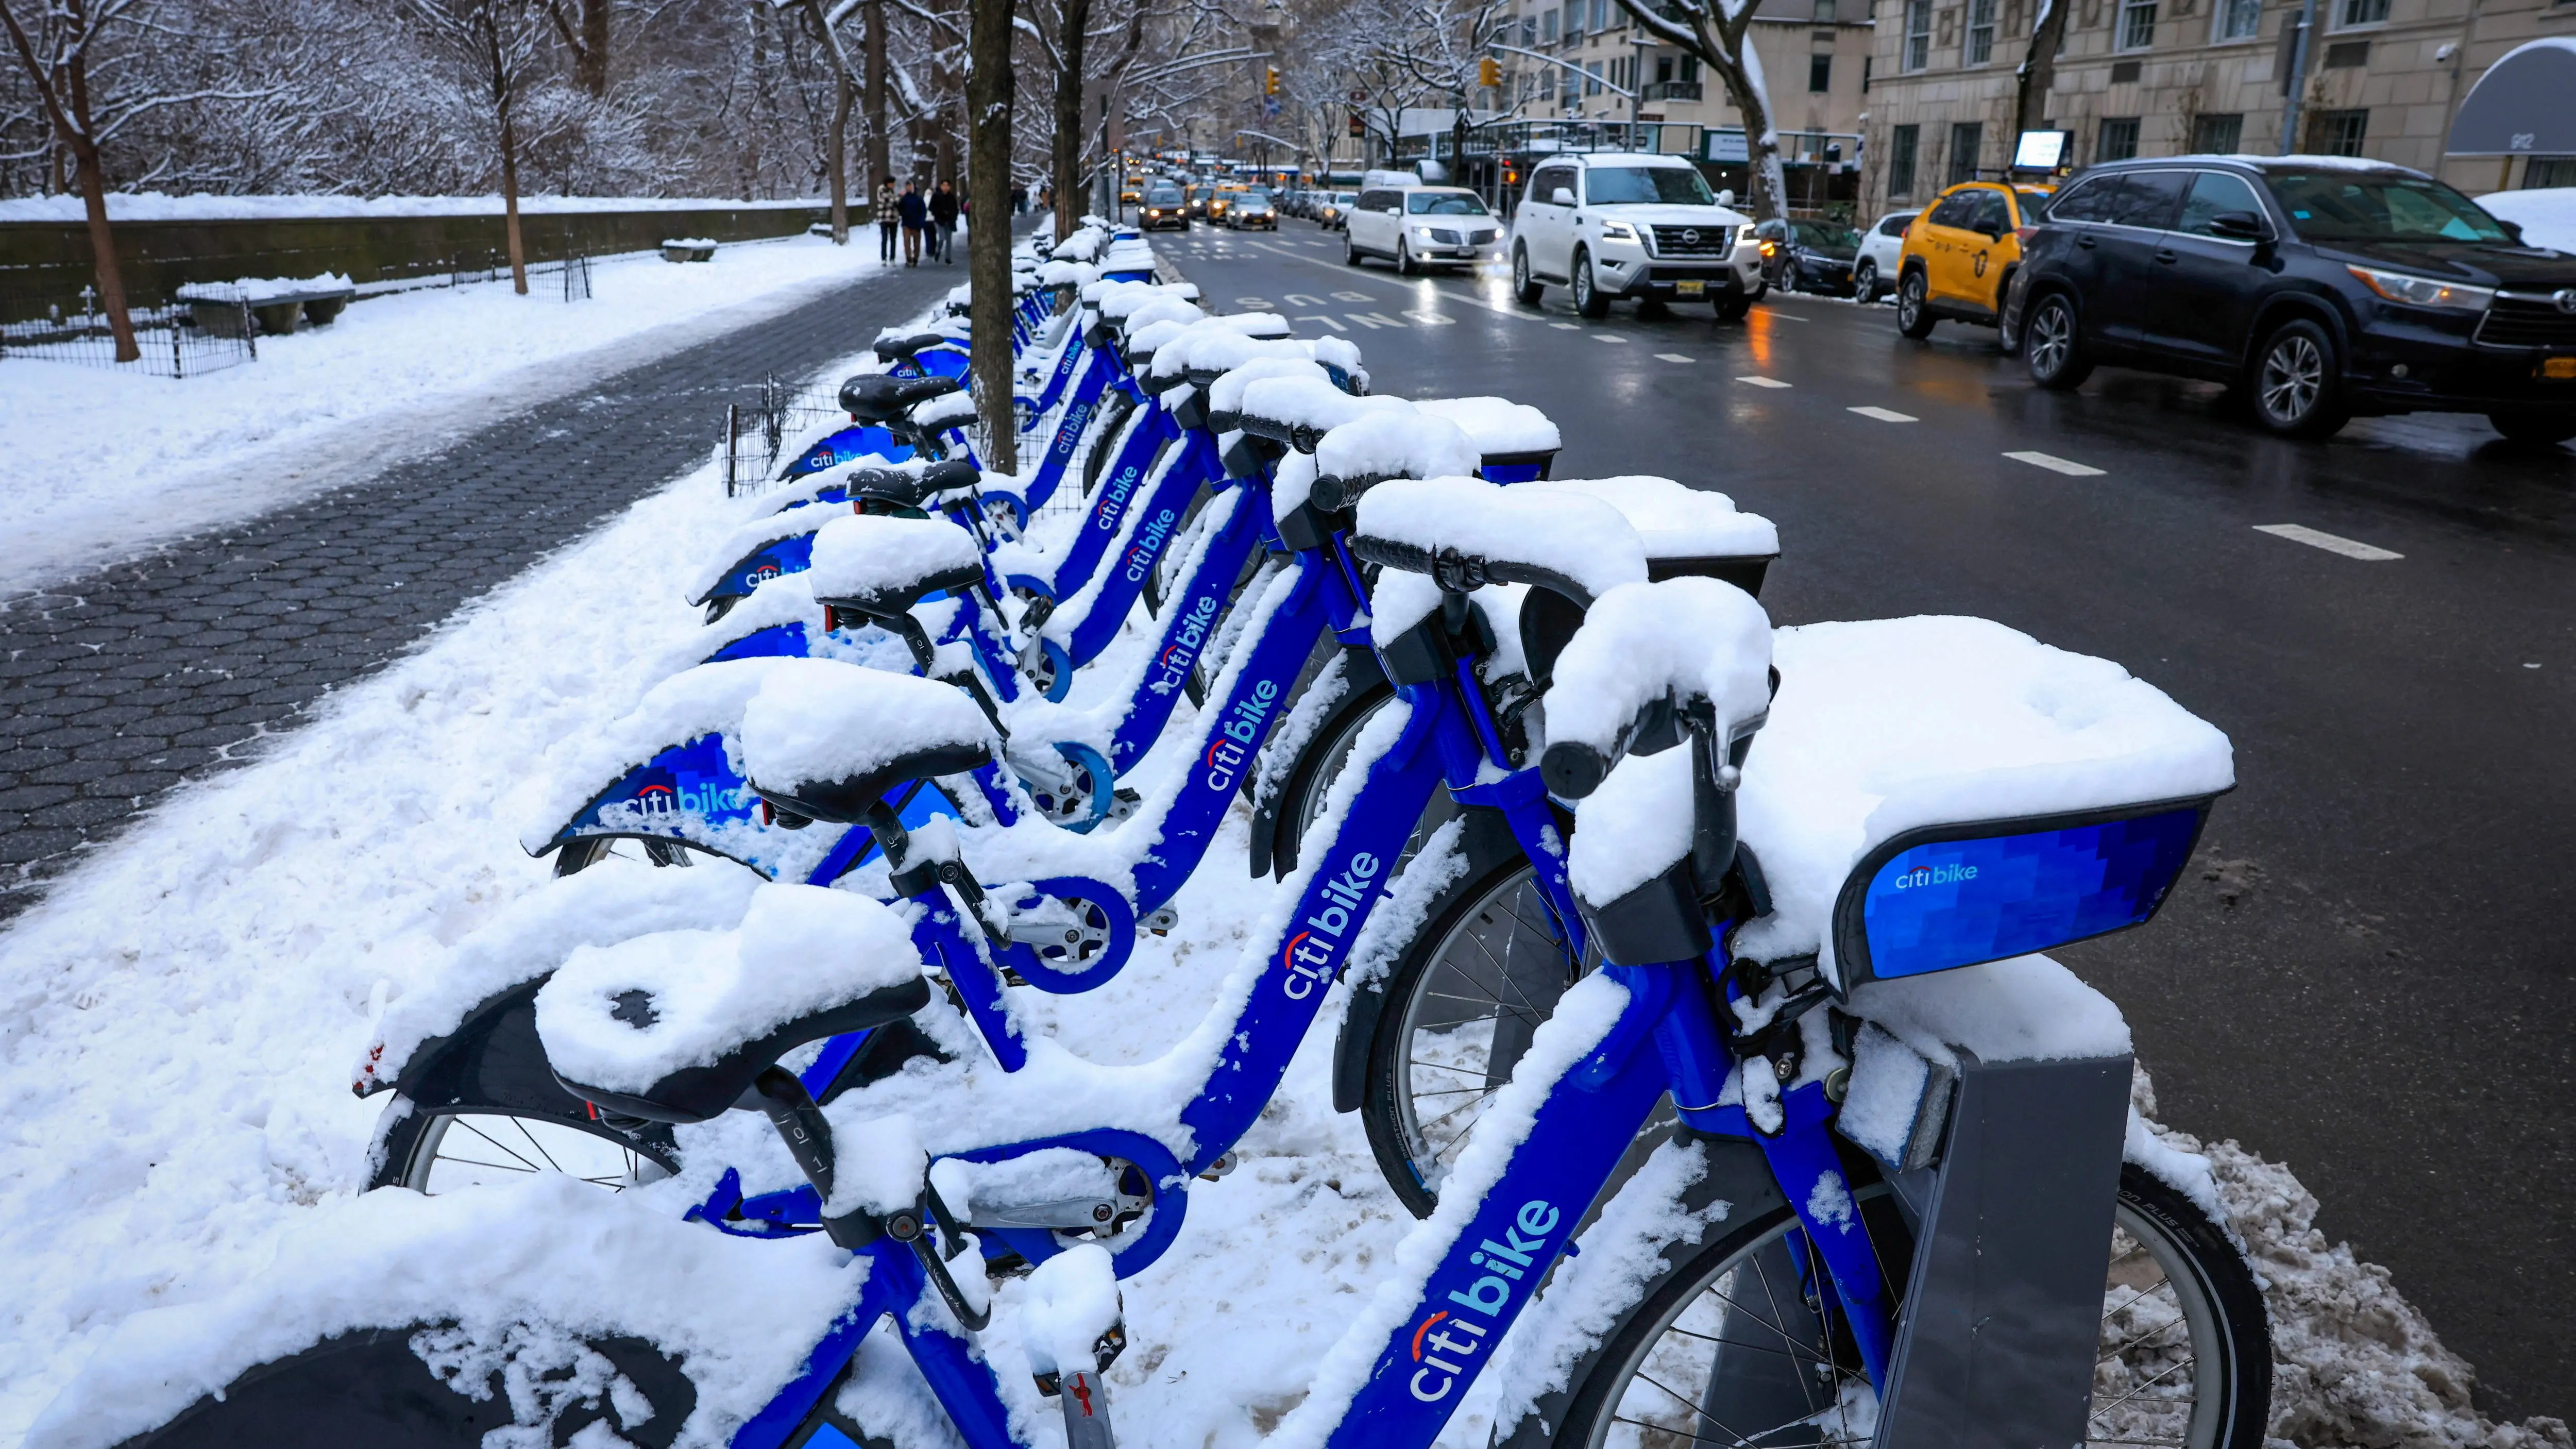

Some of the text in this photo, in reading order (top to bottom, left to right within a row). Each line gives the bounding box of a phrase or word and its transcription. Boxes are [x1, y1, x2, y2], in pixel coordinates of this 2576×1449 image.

[1235, 291, 1377, 310] BUS
[1291, 309, 1457, 334] ONL
[1061, 358, 1073, 375] citi
[1058, 404, 1088, 453] citi bike
[810, 451, 833, 467] citi
[1098, 466, 1138, 530] citi bike
[1126, 509, 1175, 582] citi bike
[1163, 596, 1217, 689] citi bike
[1208, 680, 1278, 791] citi bike
[1895, 863, 1978, 889] citi bike
[1283, 852, 1379, 1000] citi bike
[1388, 1105, 1410, 1159] MARATHON
[2143, 1202, 2179, 1227] PLUS
[1410, 1200, 1560, 1402] citi bike
